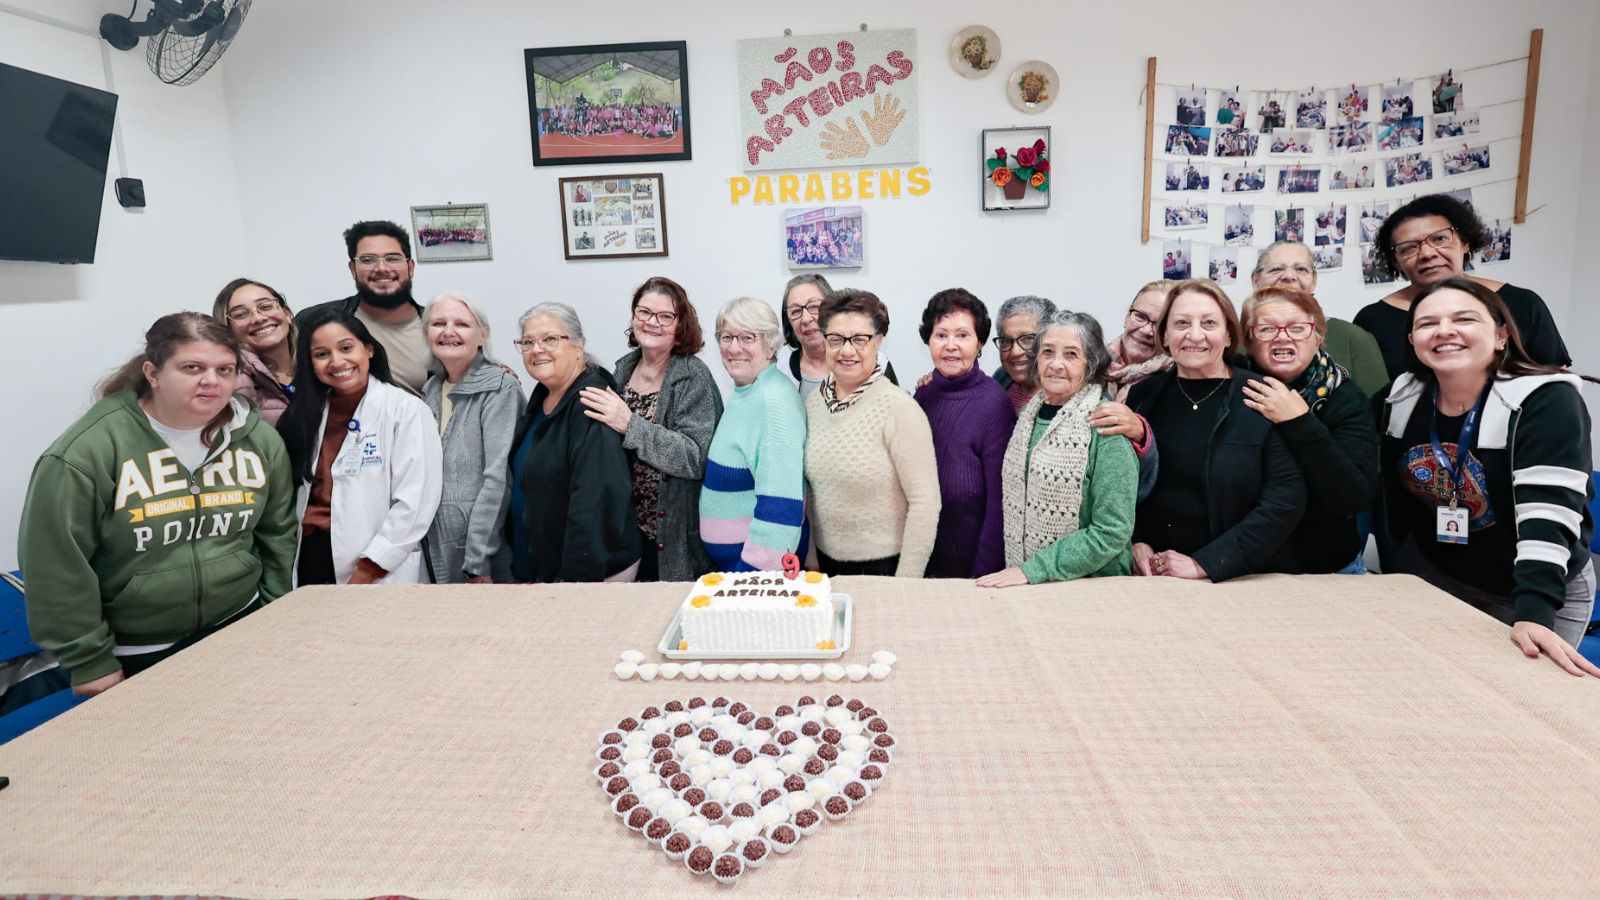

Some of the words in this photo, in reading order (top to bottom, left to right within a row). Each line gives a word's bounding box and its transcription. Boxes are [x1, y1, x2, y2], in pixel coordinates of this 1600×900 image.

[751, 40, 856, 115] MÃOS
[746, 50, 913, 165] ARTEIRAS
[728, 167, 932, 204] PARABENS
[204, 493, 243, 506] BRAND
[133, 509, 254, 552] POINT
[733, 576, 784, 587] MÃOS
[781, 552, 800, 580] 9
[713, 588, 800, 598] ARTEIRAS
